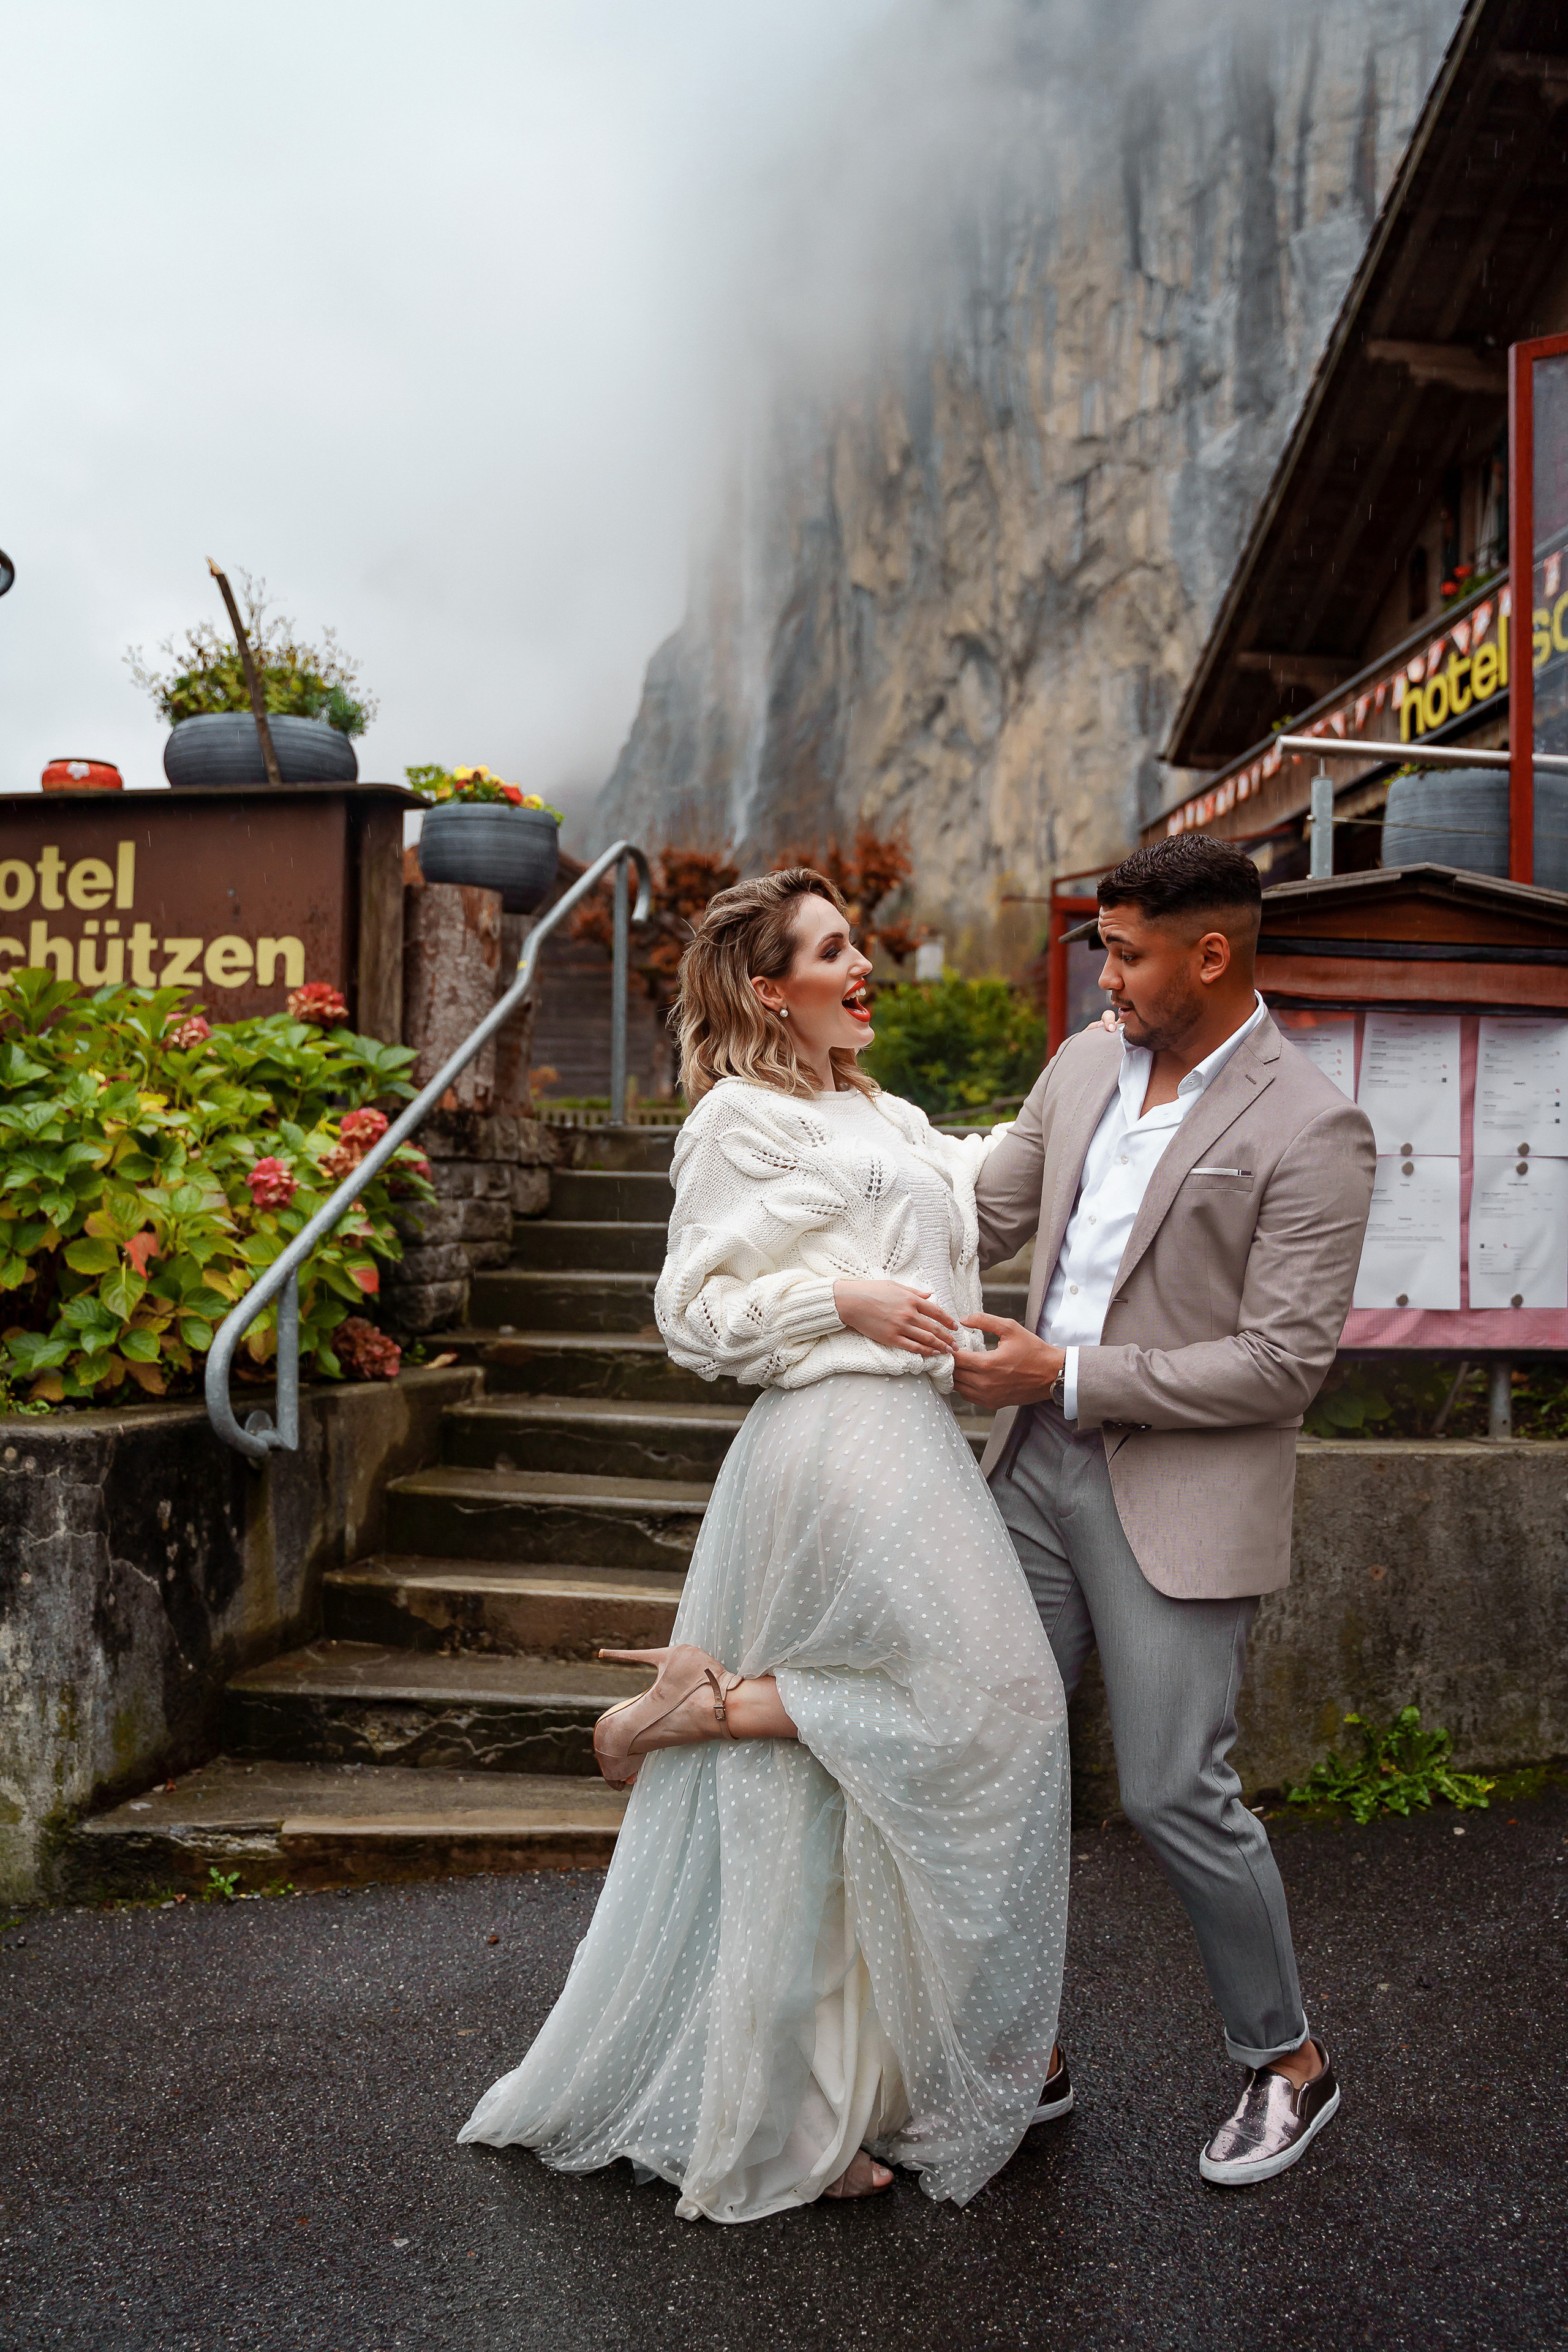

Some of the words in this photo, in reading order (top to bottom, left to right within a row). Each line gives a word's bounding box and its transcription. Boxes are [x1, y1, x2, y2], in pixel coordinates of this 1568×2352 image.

[1400, 615, 1508, 742] hotel
[0, 841, 135, 911] otel
[0, 919, 306, 989] chützen
